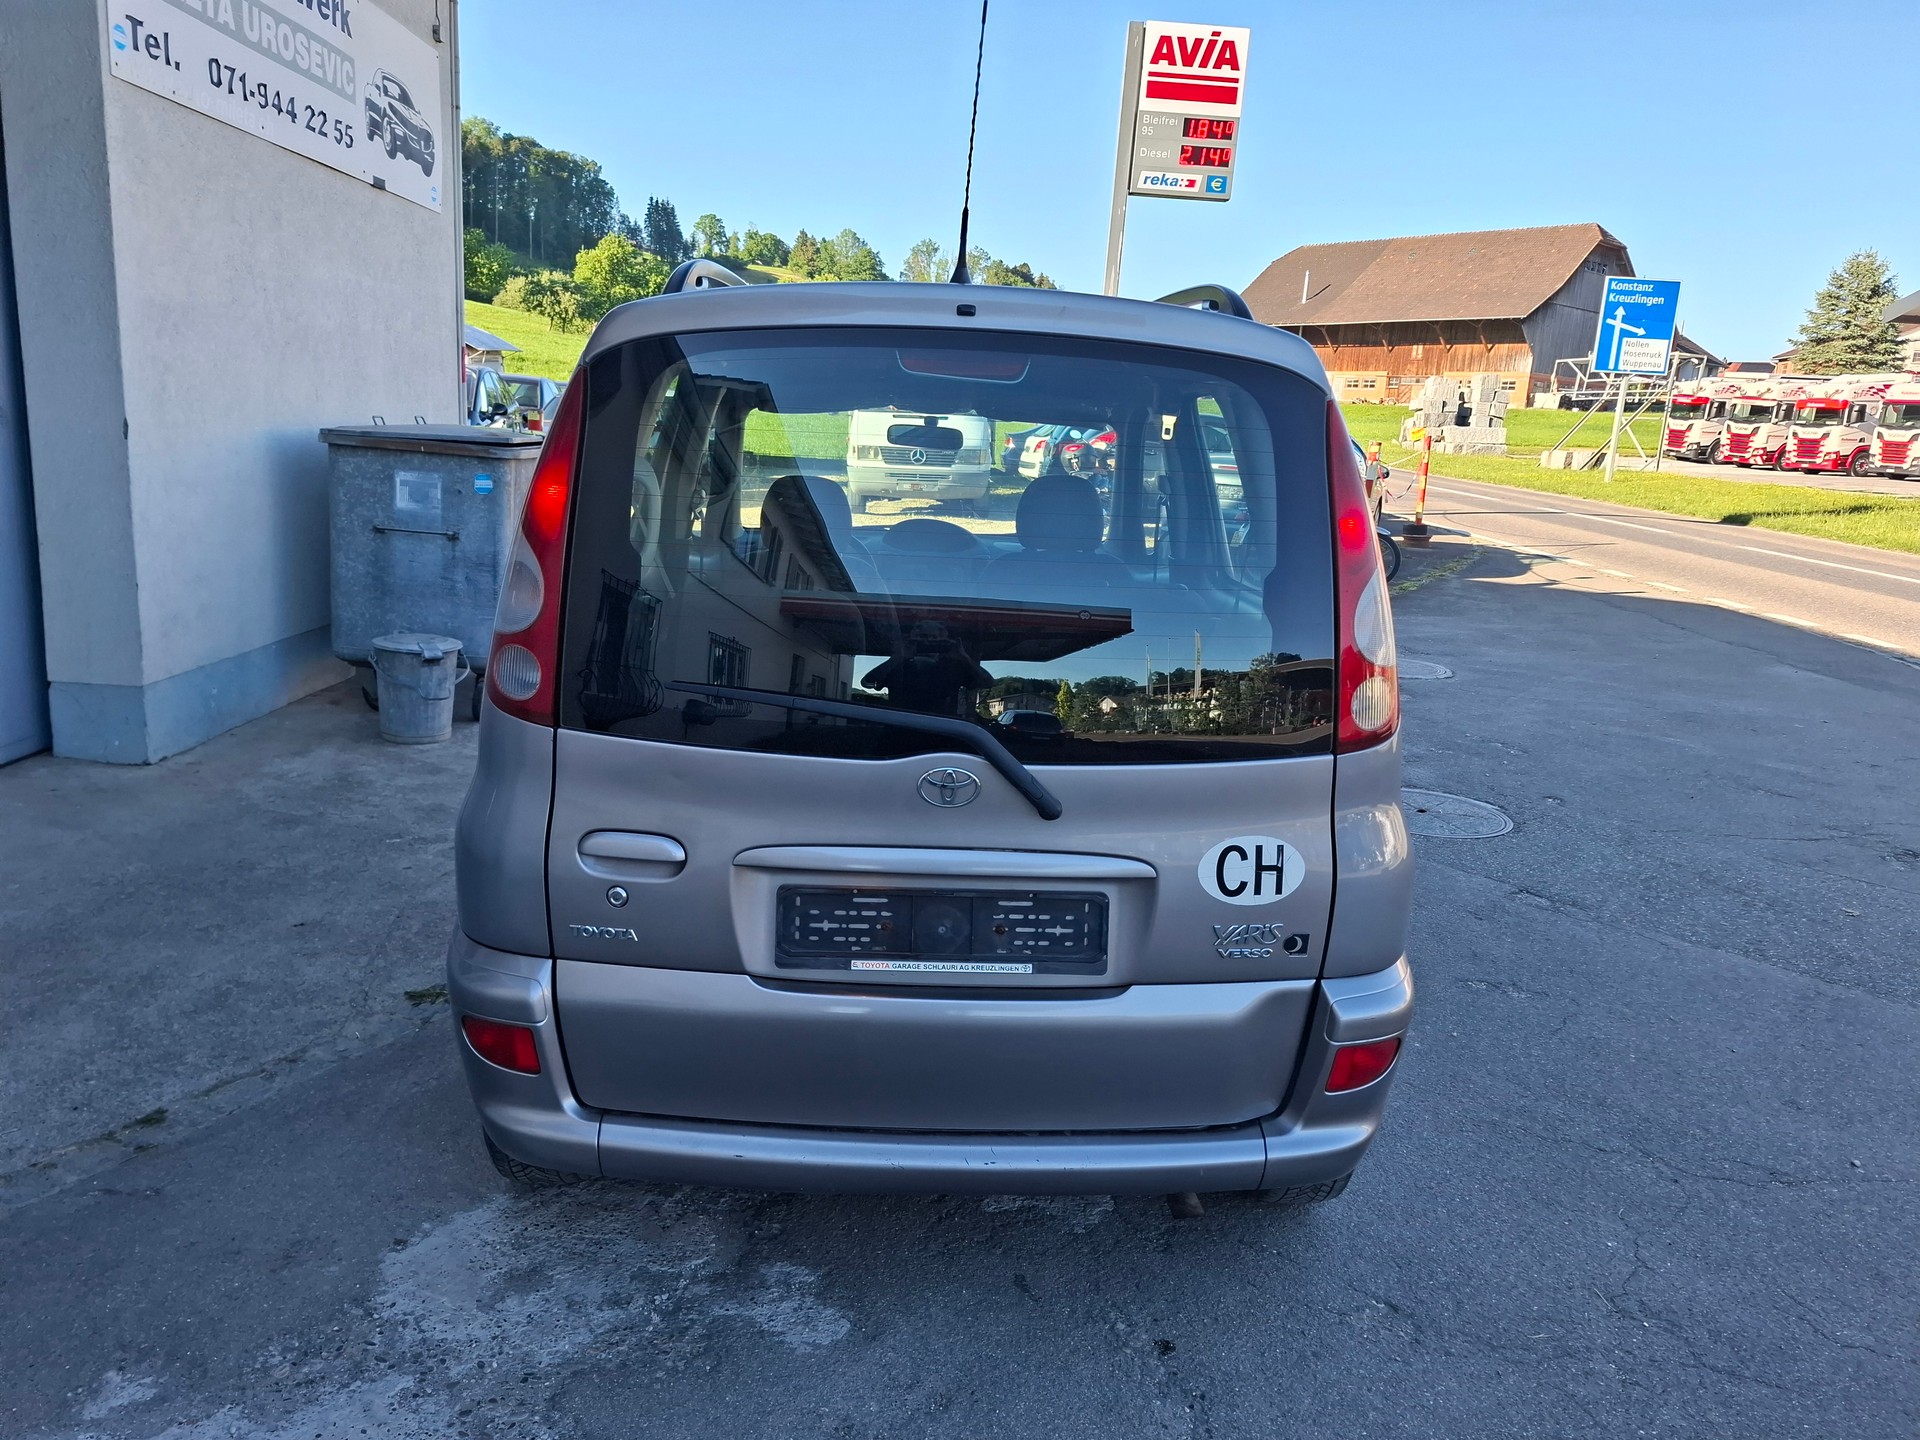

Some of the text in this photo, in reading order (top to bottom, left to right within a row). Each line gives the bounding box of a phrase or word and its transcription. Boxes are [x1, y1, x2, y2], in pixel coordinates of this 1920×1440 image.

[125, 14, 181, 71] Tel.
[242, 0, 354, 96] UROSEVIC
[208, 57, 298, 124] 071-944
[304, 104, 329, 138] 22
[334, 119, 354, 149] 55
[1143, 114, 1178, 126] Bleifrei
[1141, 126, 1154, 136] 95
[1139, 147, 1171, 159] Diesel
[1611, 281, 1654, 292] Konstanz
[1609, 293, 1665, 306] Kreuzlingen
[1624, 340, 1650, 349] Nollen
[1623, 350, 1663, 359] Hosenruck
[1622, 359, 1662, 369] Wuppenau
[1215, 844, 1285, 898] CH
[569, 924, 638, 941] TOYOTA
[1213, 923, 1284, 946] YARIS
[1217, 947, 1274, 960] VERSO
[891, 962, 922, 970] GARAGE
[923, 963, 958, 971] SCHLAURI
[971, 964, 1020, 972] KREUZLINGEN
